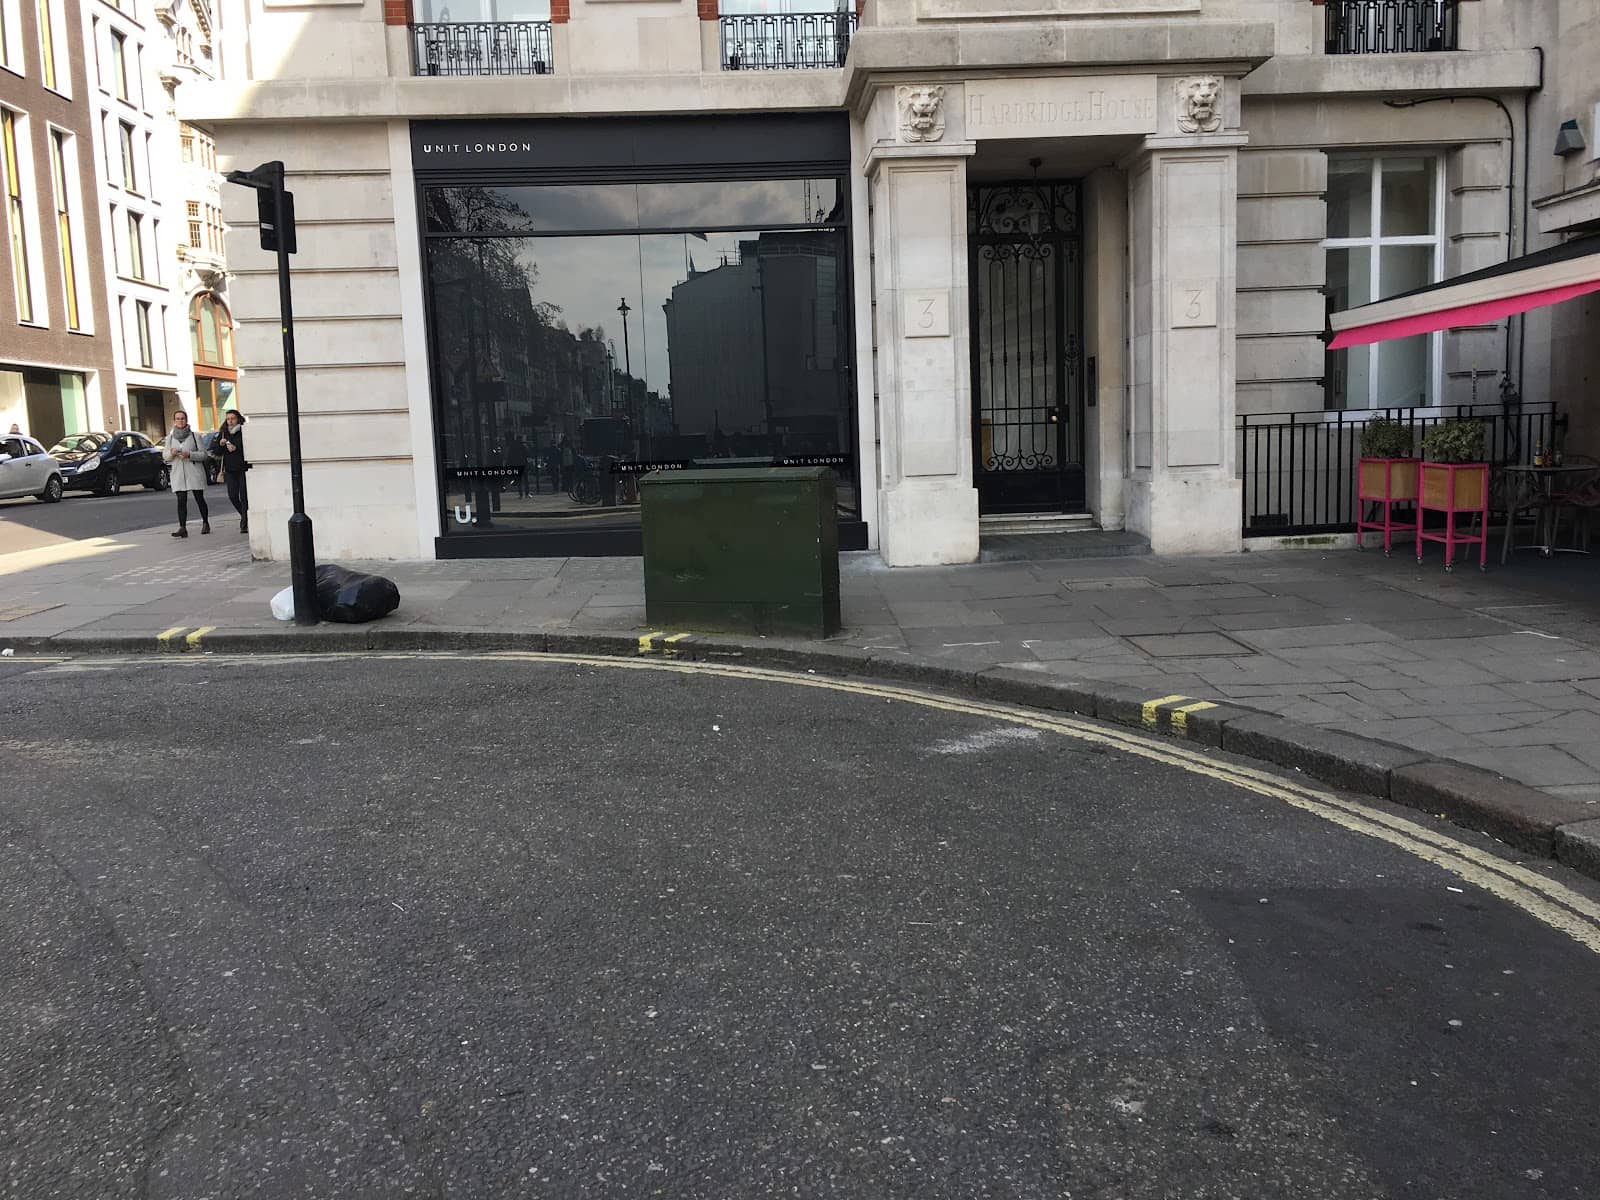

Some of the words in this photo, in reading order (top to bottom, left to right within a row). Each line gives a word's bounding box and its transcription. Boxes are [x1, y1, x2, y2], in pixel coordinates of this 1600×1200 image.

[423, 144, 460, 153] UNIT
[465, 143, 531, 153] LONDON
[917, 298, 936, 329] 3
[1184, 289, 1201, 320] 3
[646, 463, 682, 471] LONDON
